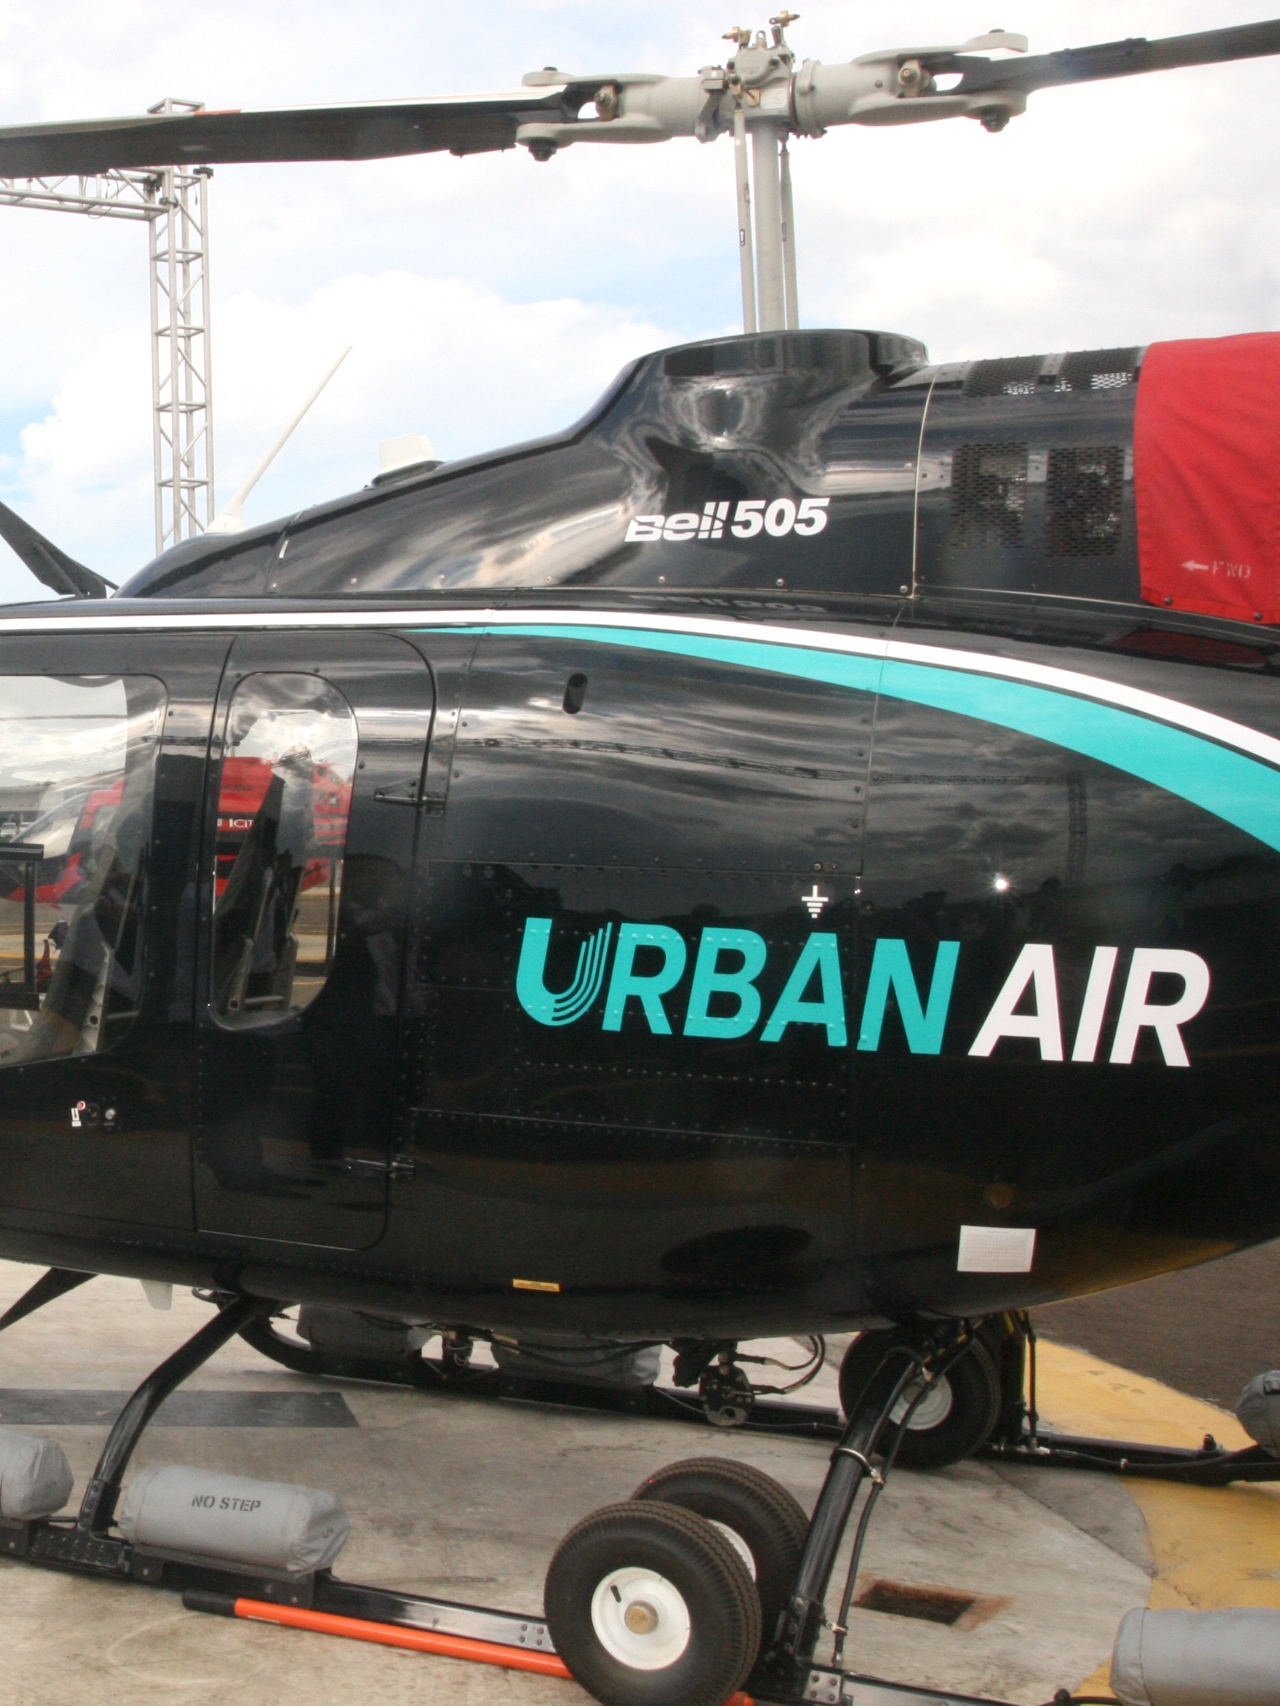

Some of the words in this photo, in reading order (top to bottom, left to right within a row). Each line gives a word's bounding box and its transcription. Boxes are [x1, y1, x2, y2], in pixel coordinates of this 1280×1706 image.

[624, 501, 730, 542] Bell
[730, 498, 830, 538] 505
[514, 917, 960, 1055] URBAN
[967, 943, 1210, 1067] AIR
[191, 1495, 216, 1508] NO
[219, 1497, 261, 1511] STEP
